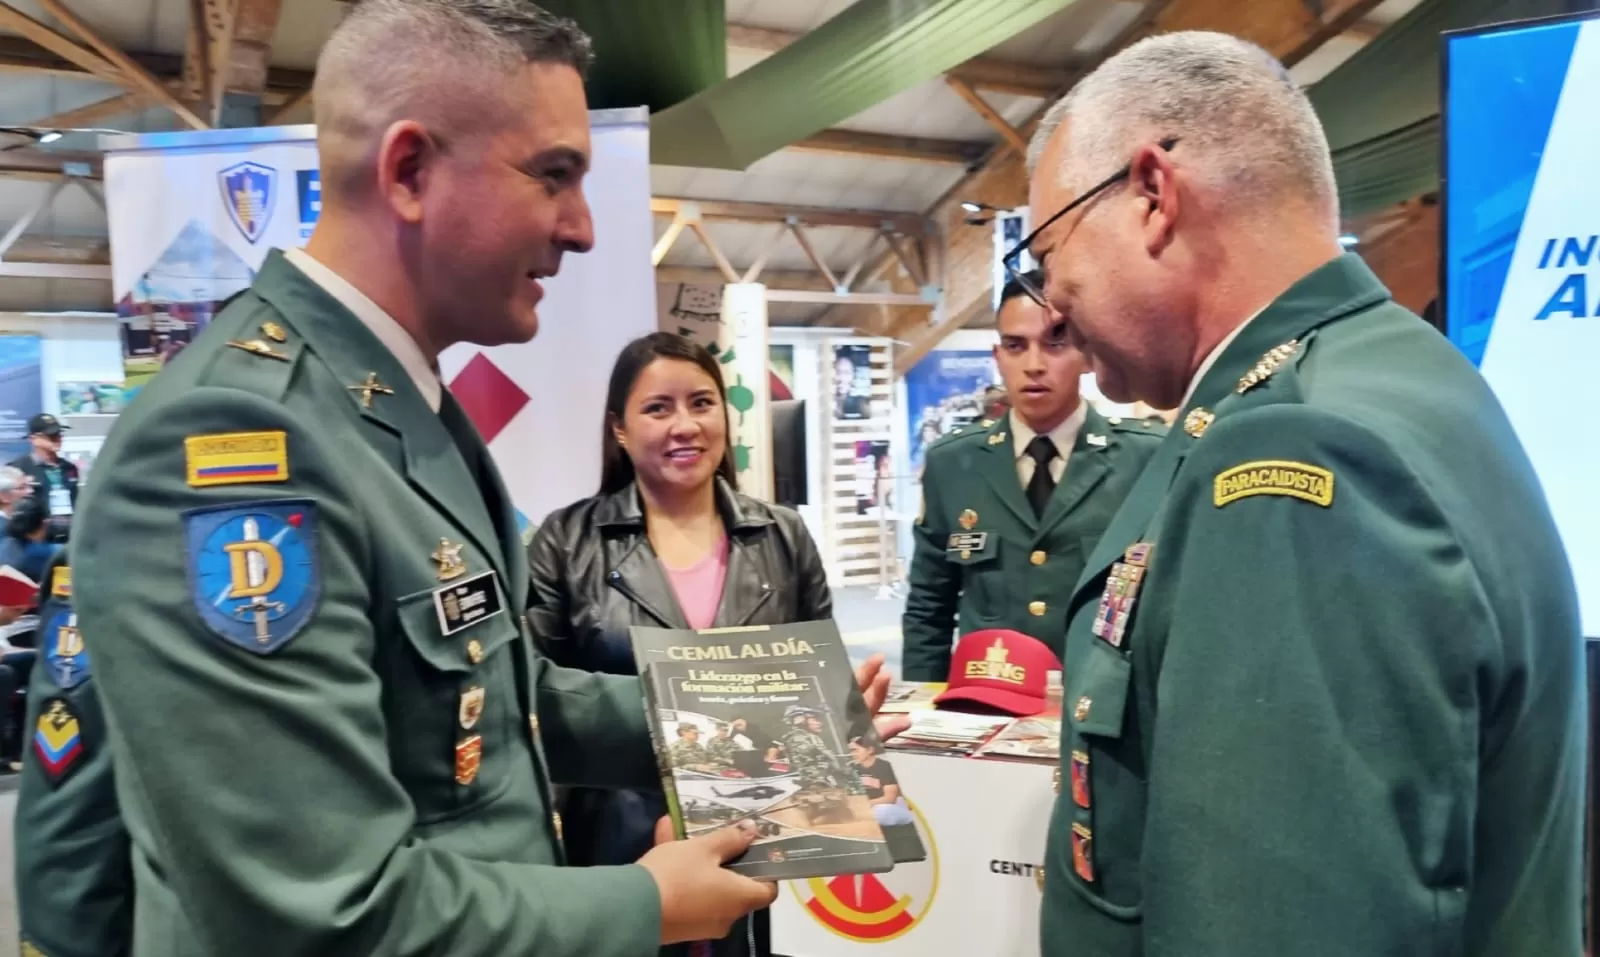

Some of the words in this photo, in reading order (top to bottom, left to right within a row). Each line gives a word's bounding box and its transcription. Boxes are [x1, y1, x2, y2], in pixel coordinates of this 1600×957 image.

[1535, 234, 1600, 270] IN
[1532, 273, 1600, 321] A
[1222, 468, 1326, 496] PARACAIDISTA
[224, 540, 284, 599] D
[667, 645, 739, 661] CEMIL
[740, 643, 771, 659] AL
[771, 637, 816, 656] DÍA
[681, 680, 756, 694] formación
[688, 669, 762, 685] Liderazgo
[989, 859, 1045, 878] CENT
